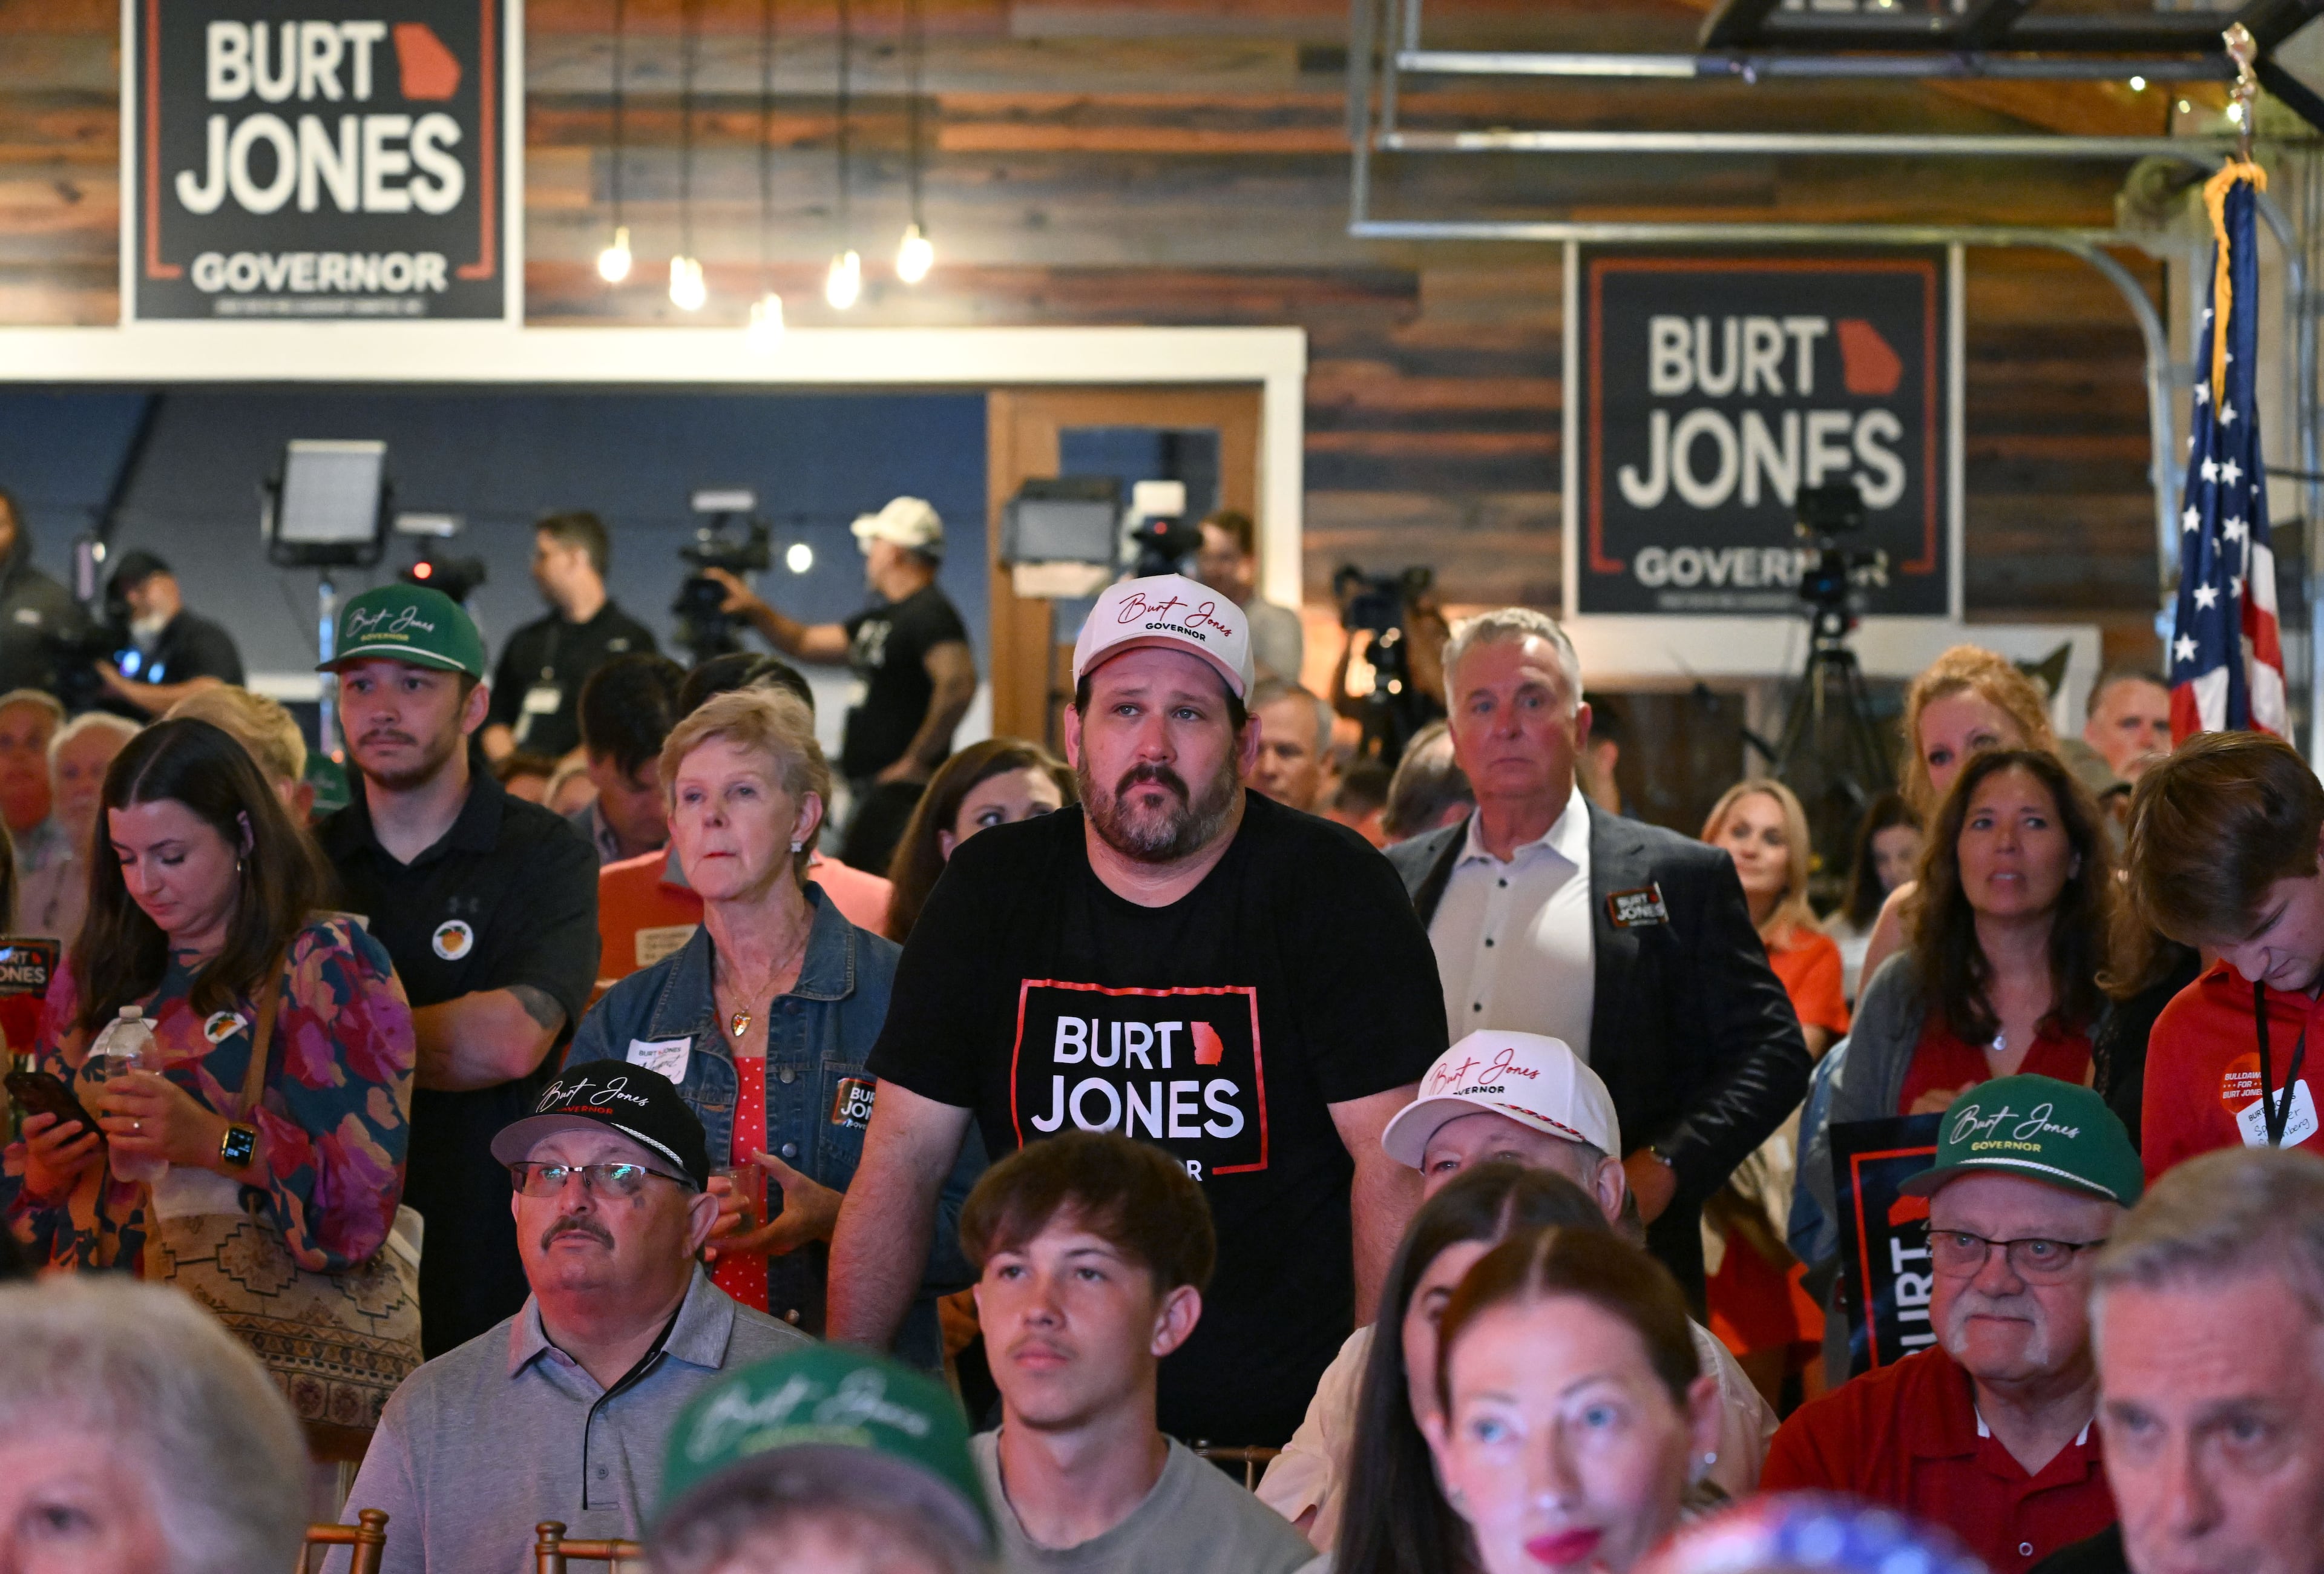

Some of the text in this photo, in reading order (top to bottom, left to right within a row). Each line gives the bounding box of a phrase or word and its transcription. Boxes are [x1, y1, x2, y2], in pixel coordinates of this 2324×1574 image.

[206, 20, 387, 102] BURT
[176, 113, 465, 214] JONES
[191, 251, 448, 293] GOVERNOR
[1649, 315, 1828, 396] BURT
[346, 605, 435, 637] Burt Jones
[1118, 593, 1232, 637] Burt Jones
[1146, 622, 1206, 642] GOVERNOR
[1617, 904, 1664, 921] JONES
[0, 965, 46, 984] ONES
[1054, 1016, 1183, 1069] BURT
[1430, 1048, 1540, 1095] Burt Jones
[1452, 1086, 1505, 1096] VERNOR
[2224, 1072, 2262, 1081] BULLDAW
[536, 1076, 649, 1113] Burt Jones
[1031, 1075, 1244, 1139] JONES
[2222, 1090, 2240, 1099] BURT
[1949, 1102, 2080, 1144] Burt Jones
[1971, 1141, 2041, 1153] GOVERNOR
[1889, 1236, 1938, 1356] URT
